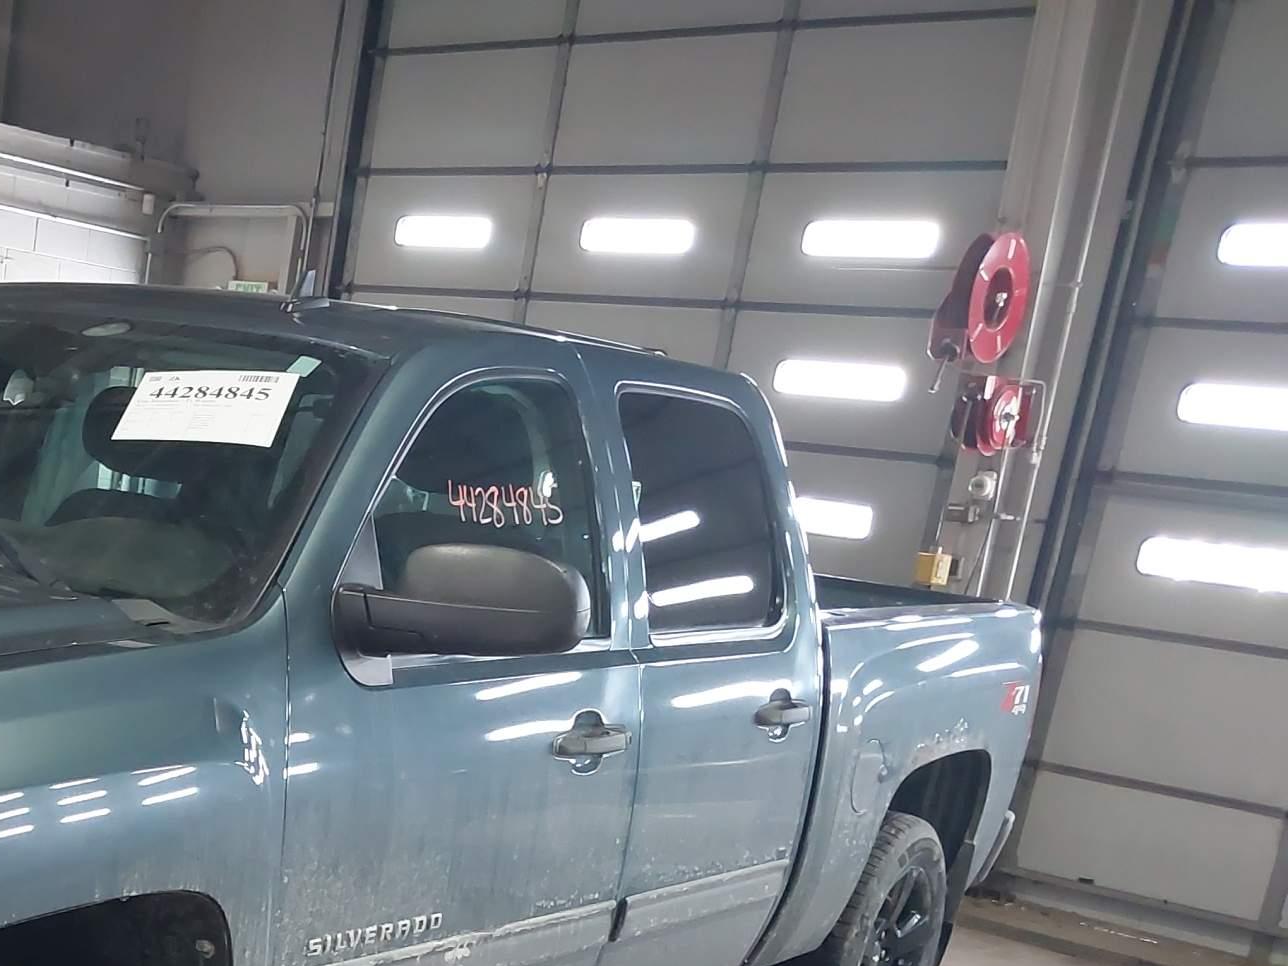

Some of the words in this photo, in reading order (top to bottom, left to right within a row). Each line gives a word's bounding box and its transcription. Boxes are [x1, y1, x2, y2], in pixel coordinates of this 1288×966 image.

[149, 385, 273, 401] 44284845
[447, 479, 564, 528] 44284845
[306, 912, 443, 957] SILVERADO
